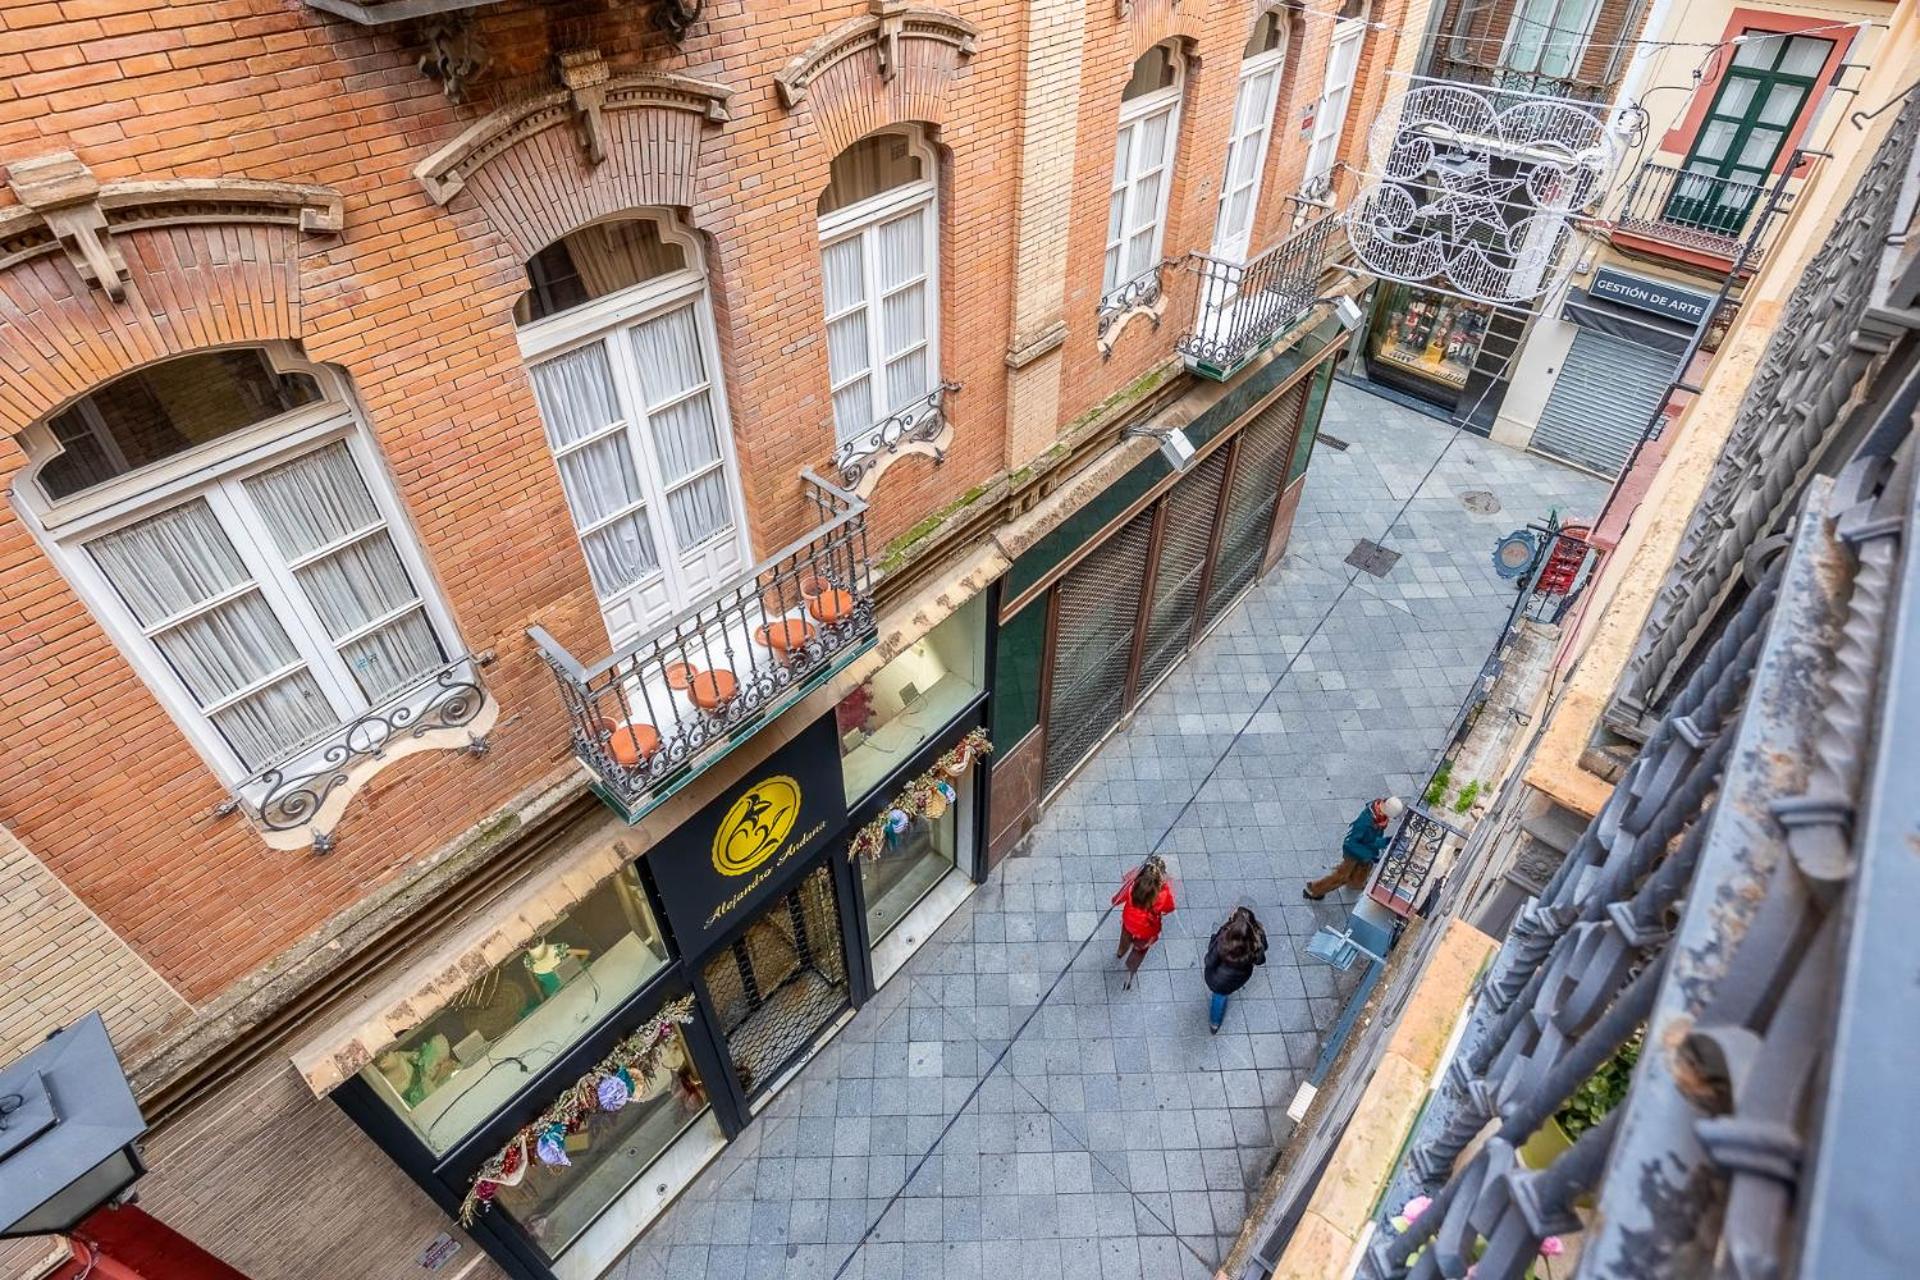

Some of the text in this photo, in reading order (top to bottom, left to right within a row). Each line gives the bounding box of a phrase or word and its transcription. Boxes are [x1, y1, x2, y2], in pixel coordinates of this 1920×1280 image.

[1597, 279, 1703, 316] GESTIÓN DE ARTE
[703, 820, 827, 930] Alejandro Andana
